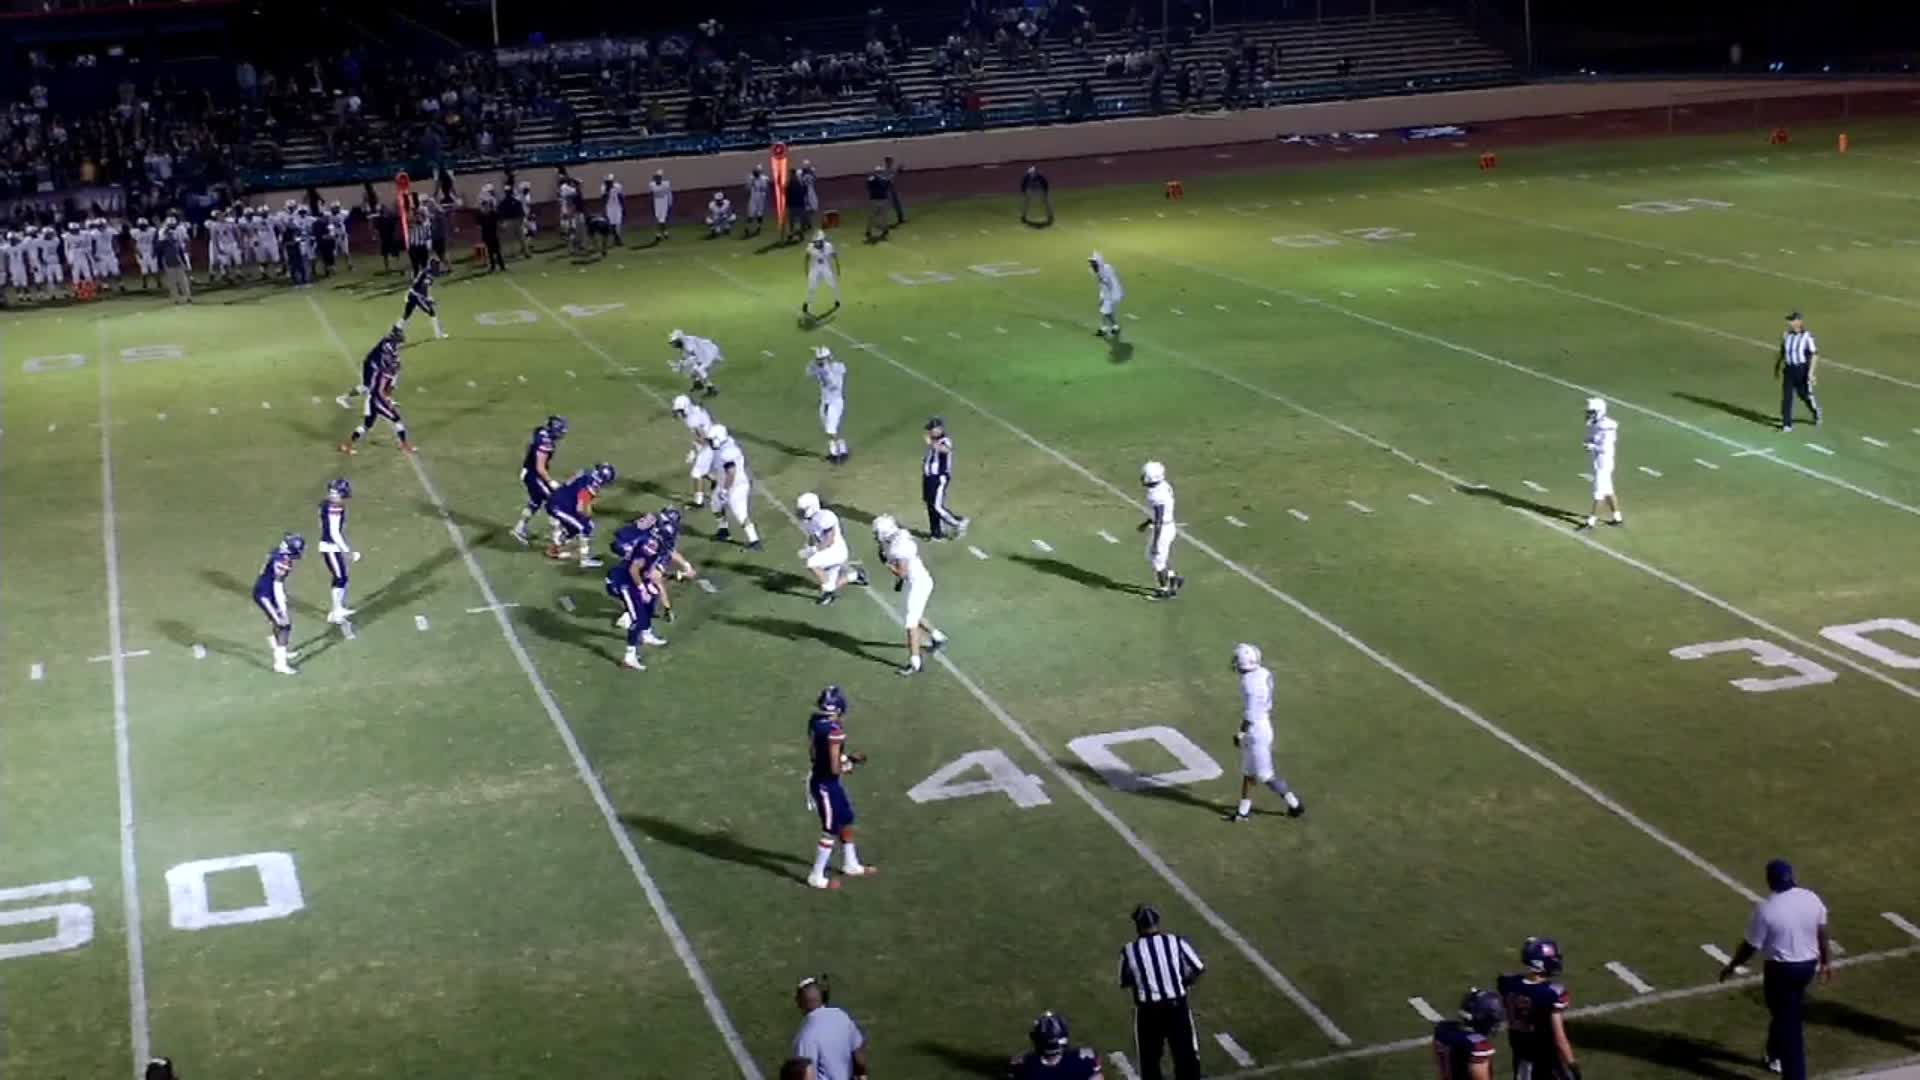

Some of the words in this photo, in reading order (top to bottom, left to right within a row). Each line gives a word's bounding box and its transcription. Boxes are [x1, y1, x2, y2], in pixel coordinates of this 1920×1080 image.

[474, 302, 625, 326] 40
[1669, 618, 1920, 692] 30
[907, 726, 1223, 808] 40
[0, 851, 305, 959] 50
